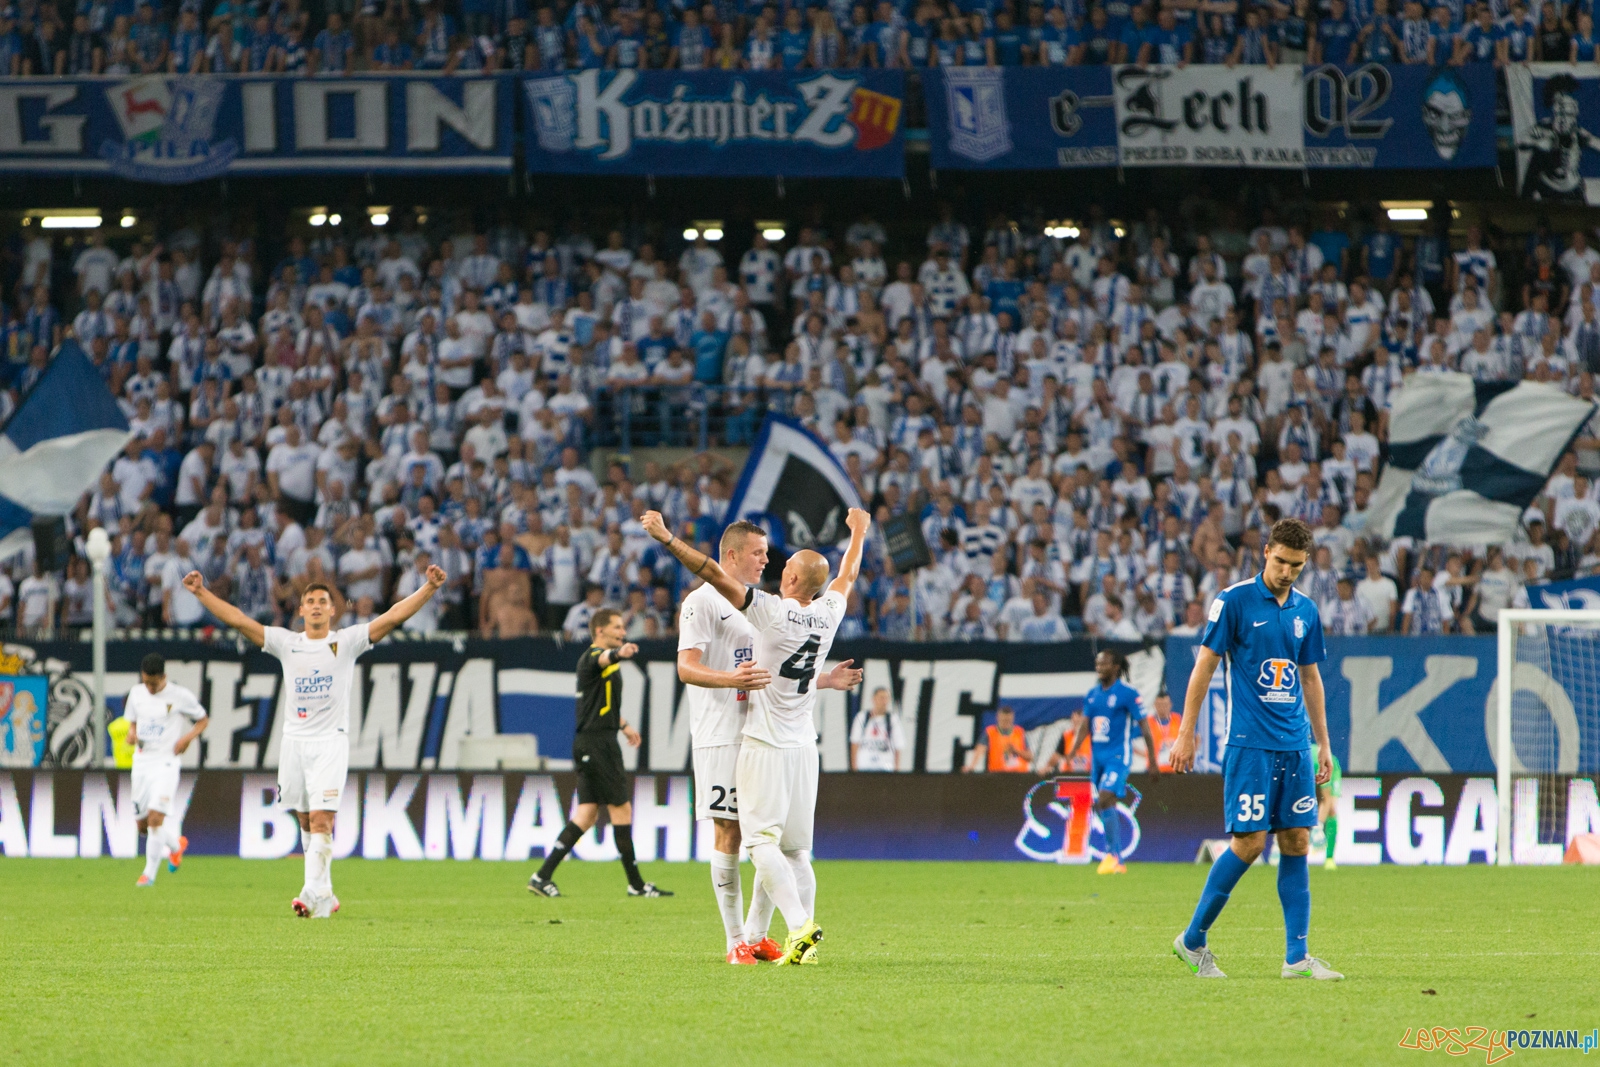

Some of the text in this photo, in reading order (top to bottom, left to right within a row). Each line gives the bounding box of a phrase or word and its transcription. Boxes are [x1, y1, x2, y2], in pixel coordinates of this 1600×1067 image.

[779, 633, 821, 694] 4
[1257, 658, 1297, 690] STS
[1015, 776, 1142, 865] STS
[1237, 793, 1266, 822] 35
